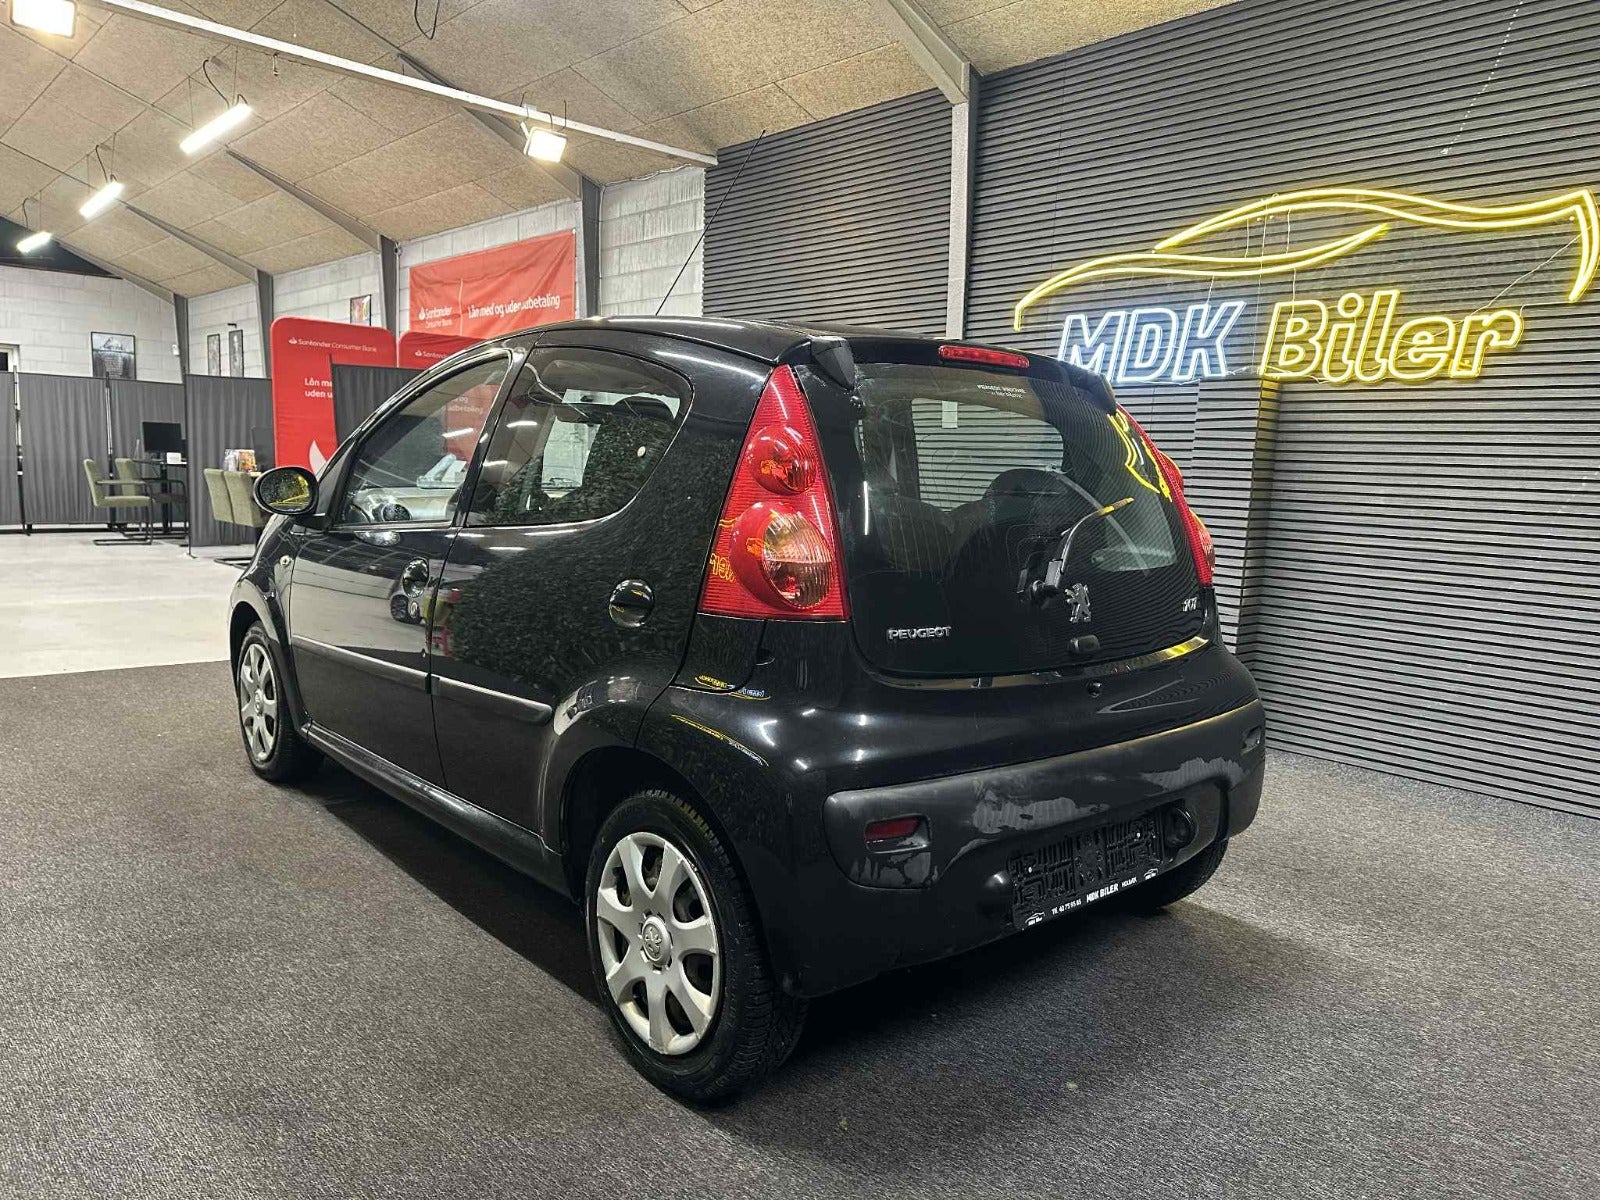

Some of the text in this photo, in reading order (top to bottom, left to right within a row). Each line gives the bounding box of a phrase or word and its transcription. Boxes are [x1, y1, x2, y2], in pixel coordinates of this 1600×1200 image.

[495, 304, 505, 318] og
[1056, 289, 1525, 385] MDK Biler
[298, 339, 332, 348] Santander
[332, 342, 362, 351] Consumer
[304, 377, 320, 386] Lån
[304, 388, 326, 398] uden
[887, 626, 952, 640] PEUGEOT
[1100, 883, 1119, 898] BILER
